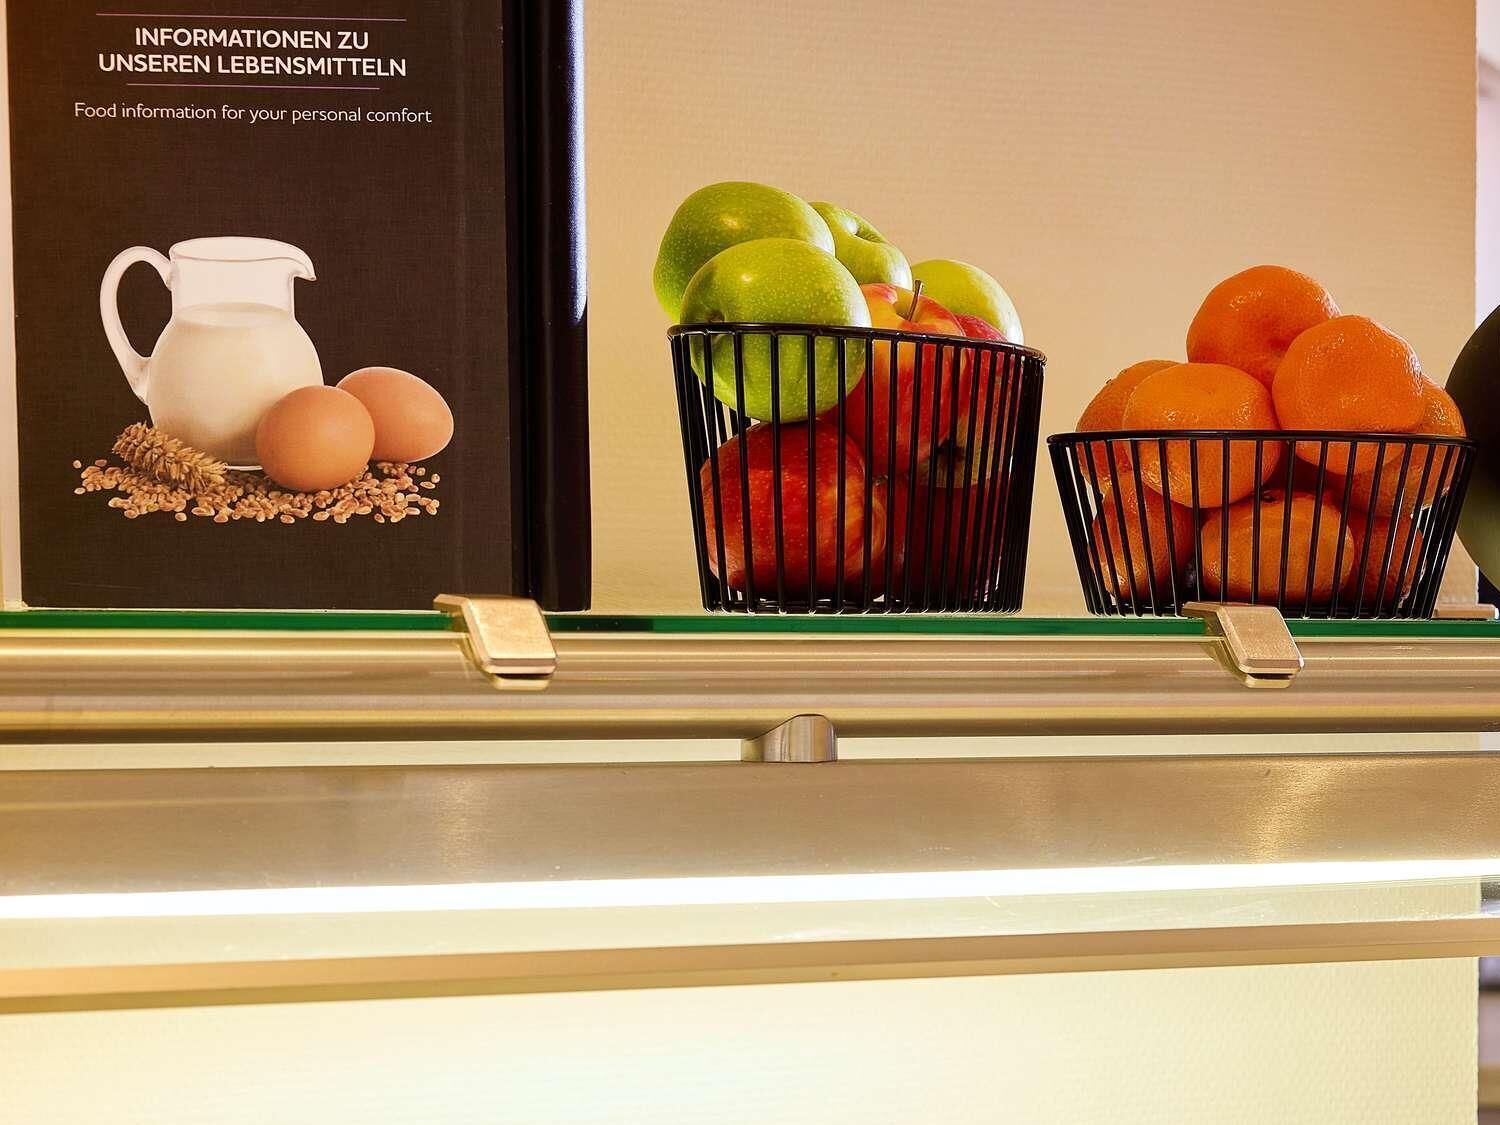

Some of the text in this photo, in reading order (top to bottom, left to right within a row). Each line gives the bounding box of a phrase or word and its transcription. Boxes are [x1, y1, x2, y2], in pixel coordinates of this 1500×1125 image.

[134, 27, 370, 50] INFORMATIONEN ZU
[98, 53, 407, 77] UNSEREN LEBENSMITTELN
[74, 102, 432, 125] Food information for your personal comfort
